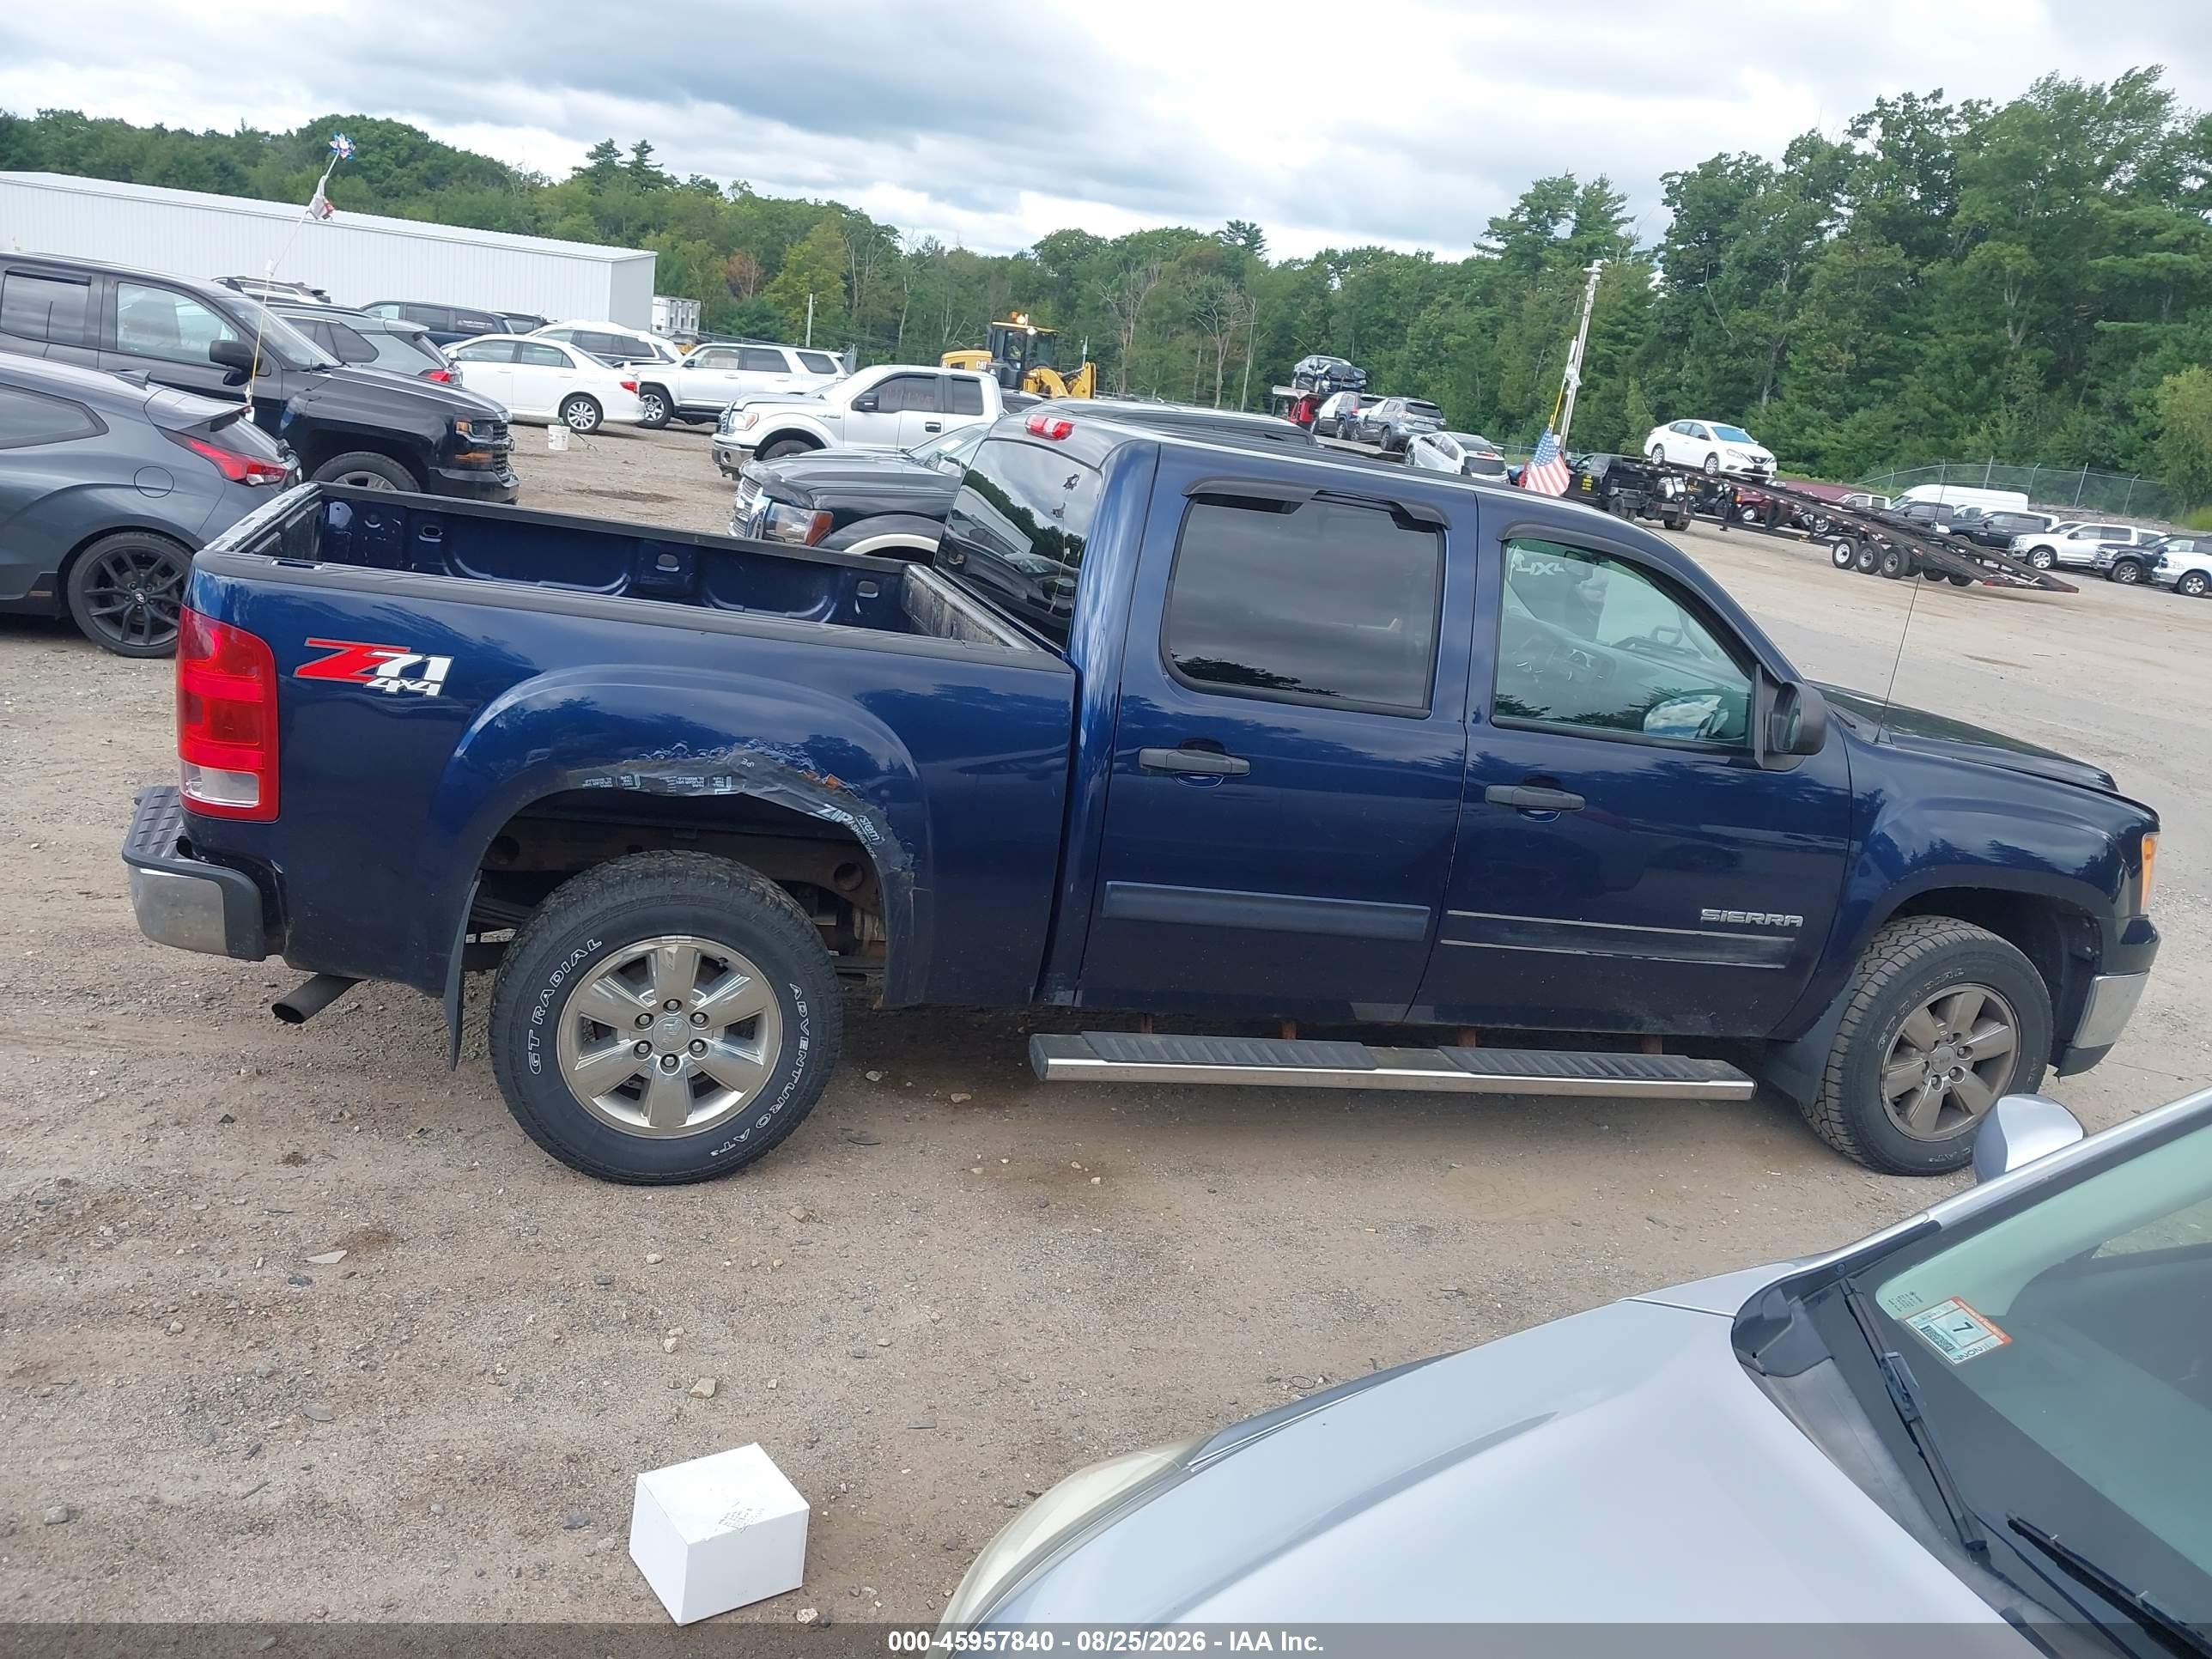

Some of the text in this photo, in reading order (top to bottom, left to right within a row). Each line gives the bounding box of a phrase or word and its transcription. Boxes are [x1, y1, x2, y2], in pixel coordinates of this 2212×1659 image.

[293, 637, 454, 684] Z71
[816, 804, 854, 823] ZIP
[1700, 908, 1804, 927] SIERRA
[528, 938, 604, 1075] GT RADIAL
[755, 982, 811, 1130] ADVENTURO
[1953, 1322, 1974, 1333] 7
